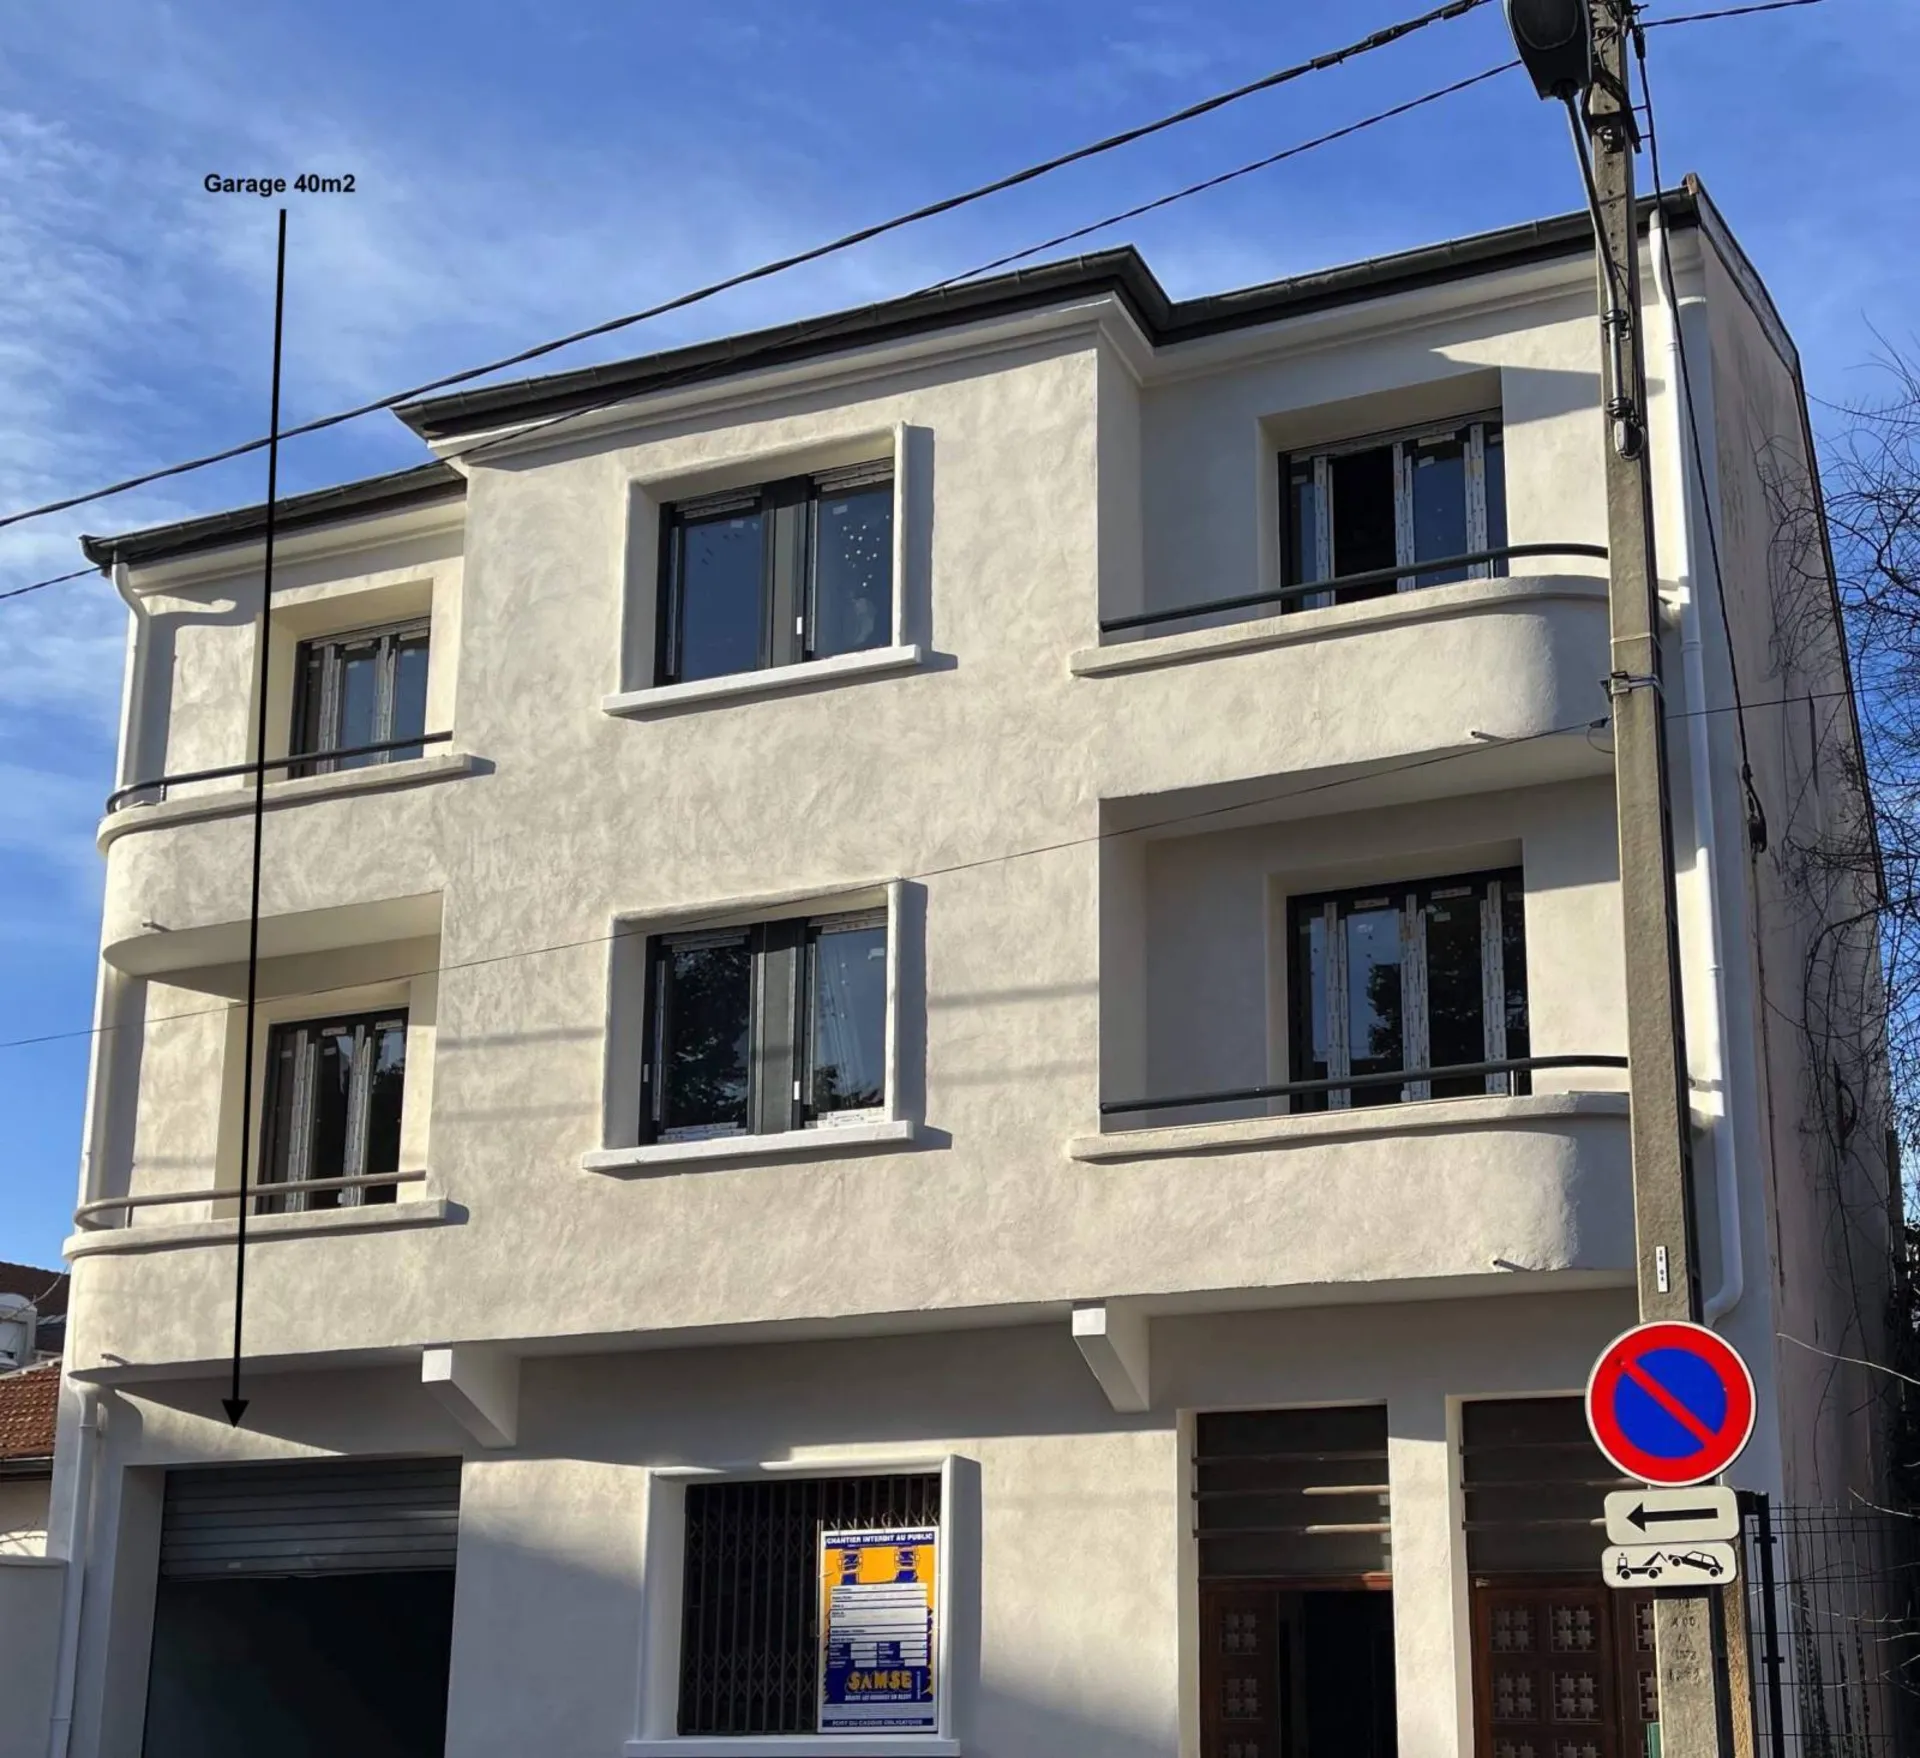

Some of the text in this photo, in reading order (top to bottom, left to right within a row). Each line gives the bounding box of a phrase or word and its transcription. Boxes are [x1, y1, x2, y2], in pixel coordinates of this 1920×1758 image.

[826, 1532, 933, 1544] CHANTIER INTERDIT AU PUBLIC
[847, 1669, 912, 1690] SAMSE
